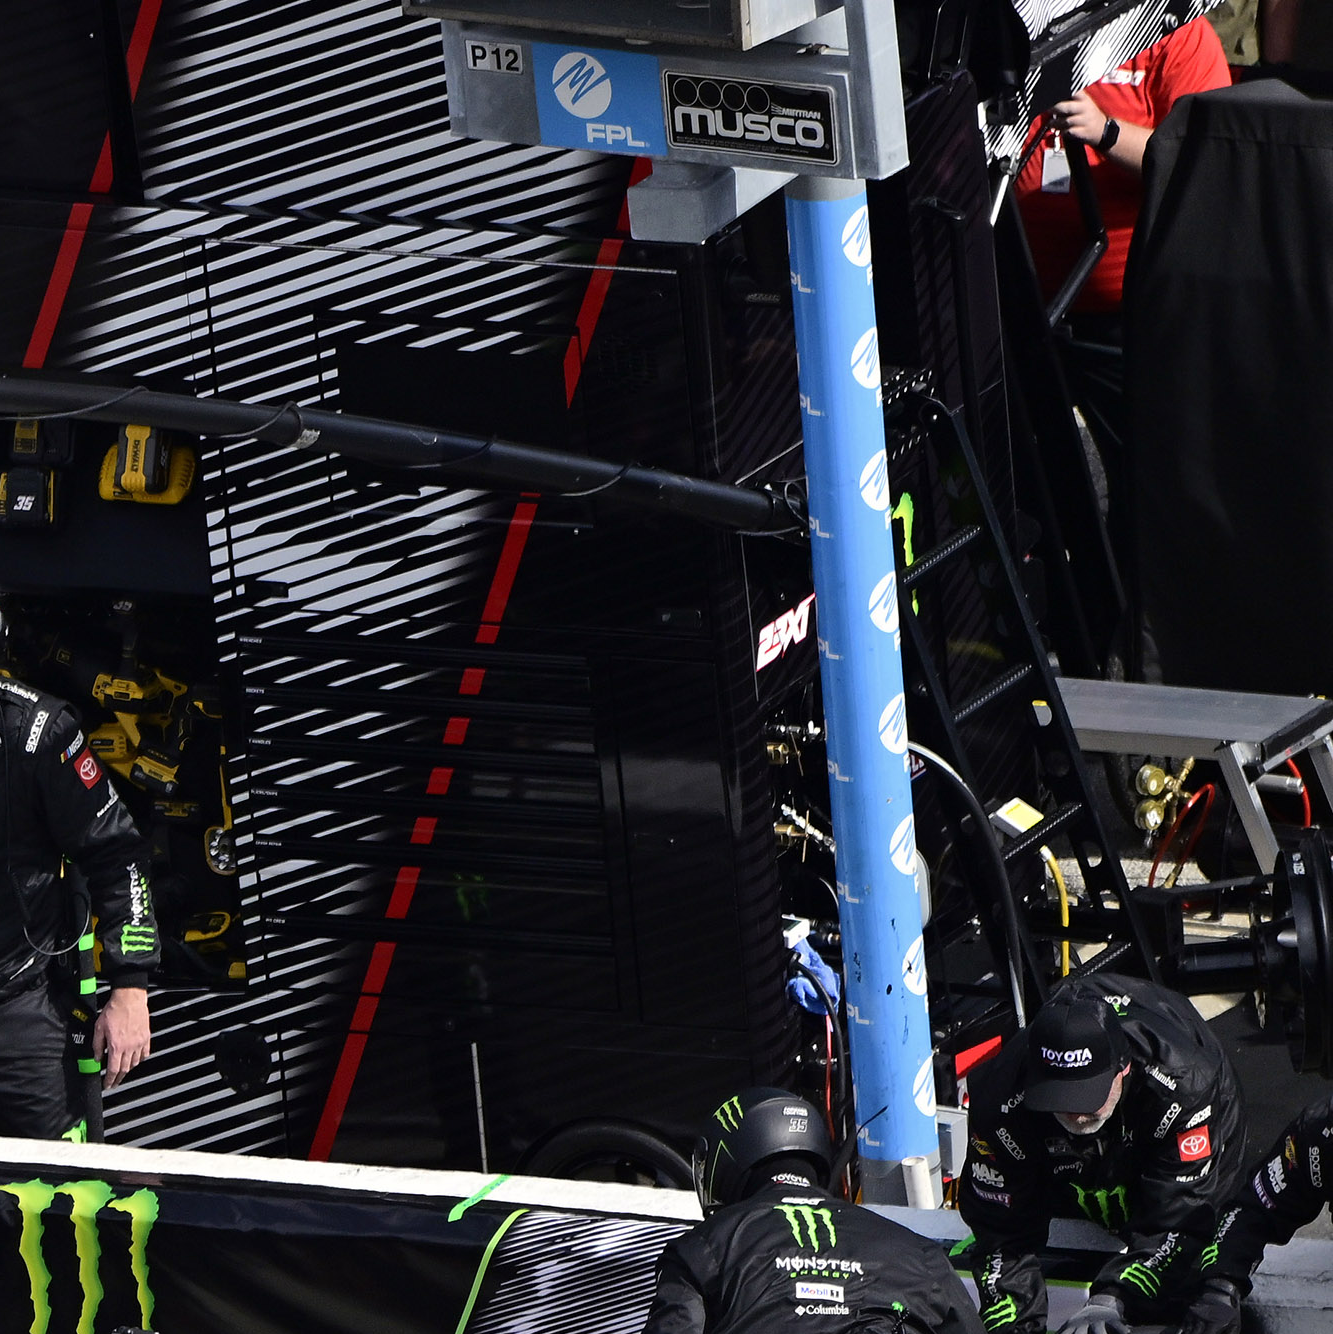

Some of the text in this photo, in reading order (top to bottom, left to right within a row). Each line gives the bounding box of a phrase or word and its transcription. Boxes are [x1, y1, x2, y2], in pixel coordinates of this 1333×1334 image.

[471, 49, 521, 72] P12
[781, 106, 822, 120] MIRTRAN
[586, 123, 645, 148] FPL
[674, 106, 826, 148] MUSCO
[13, 495, 35, 512] 35
[25, 711, 50, 754] sparco
[1040, 1046, 1093, 1063] TOYOTA
[788, 1117, 808, 1133] 35
[1153, 1101, 1182, 1140] sparco
[995, 1127, 1026, 1161] sparco
[1308, 1146, 1323, 1189] sparco
[770, 1173, 811, 1184] TOYOTA
[774, 1255, 865, 1276] MONSTER
[790, 1269, 851, 1280] ENERGY
[805, 1303, 850, 1317] Columbia
